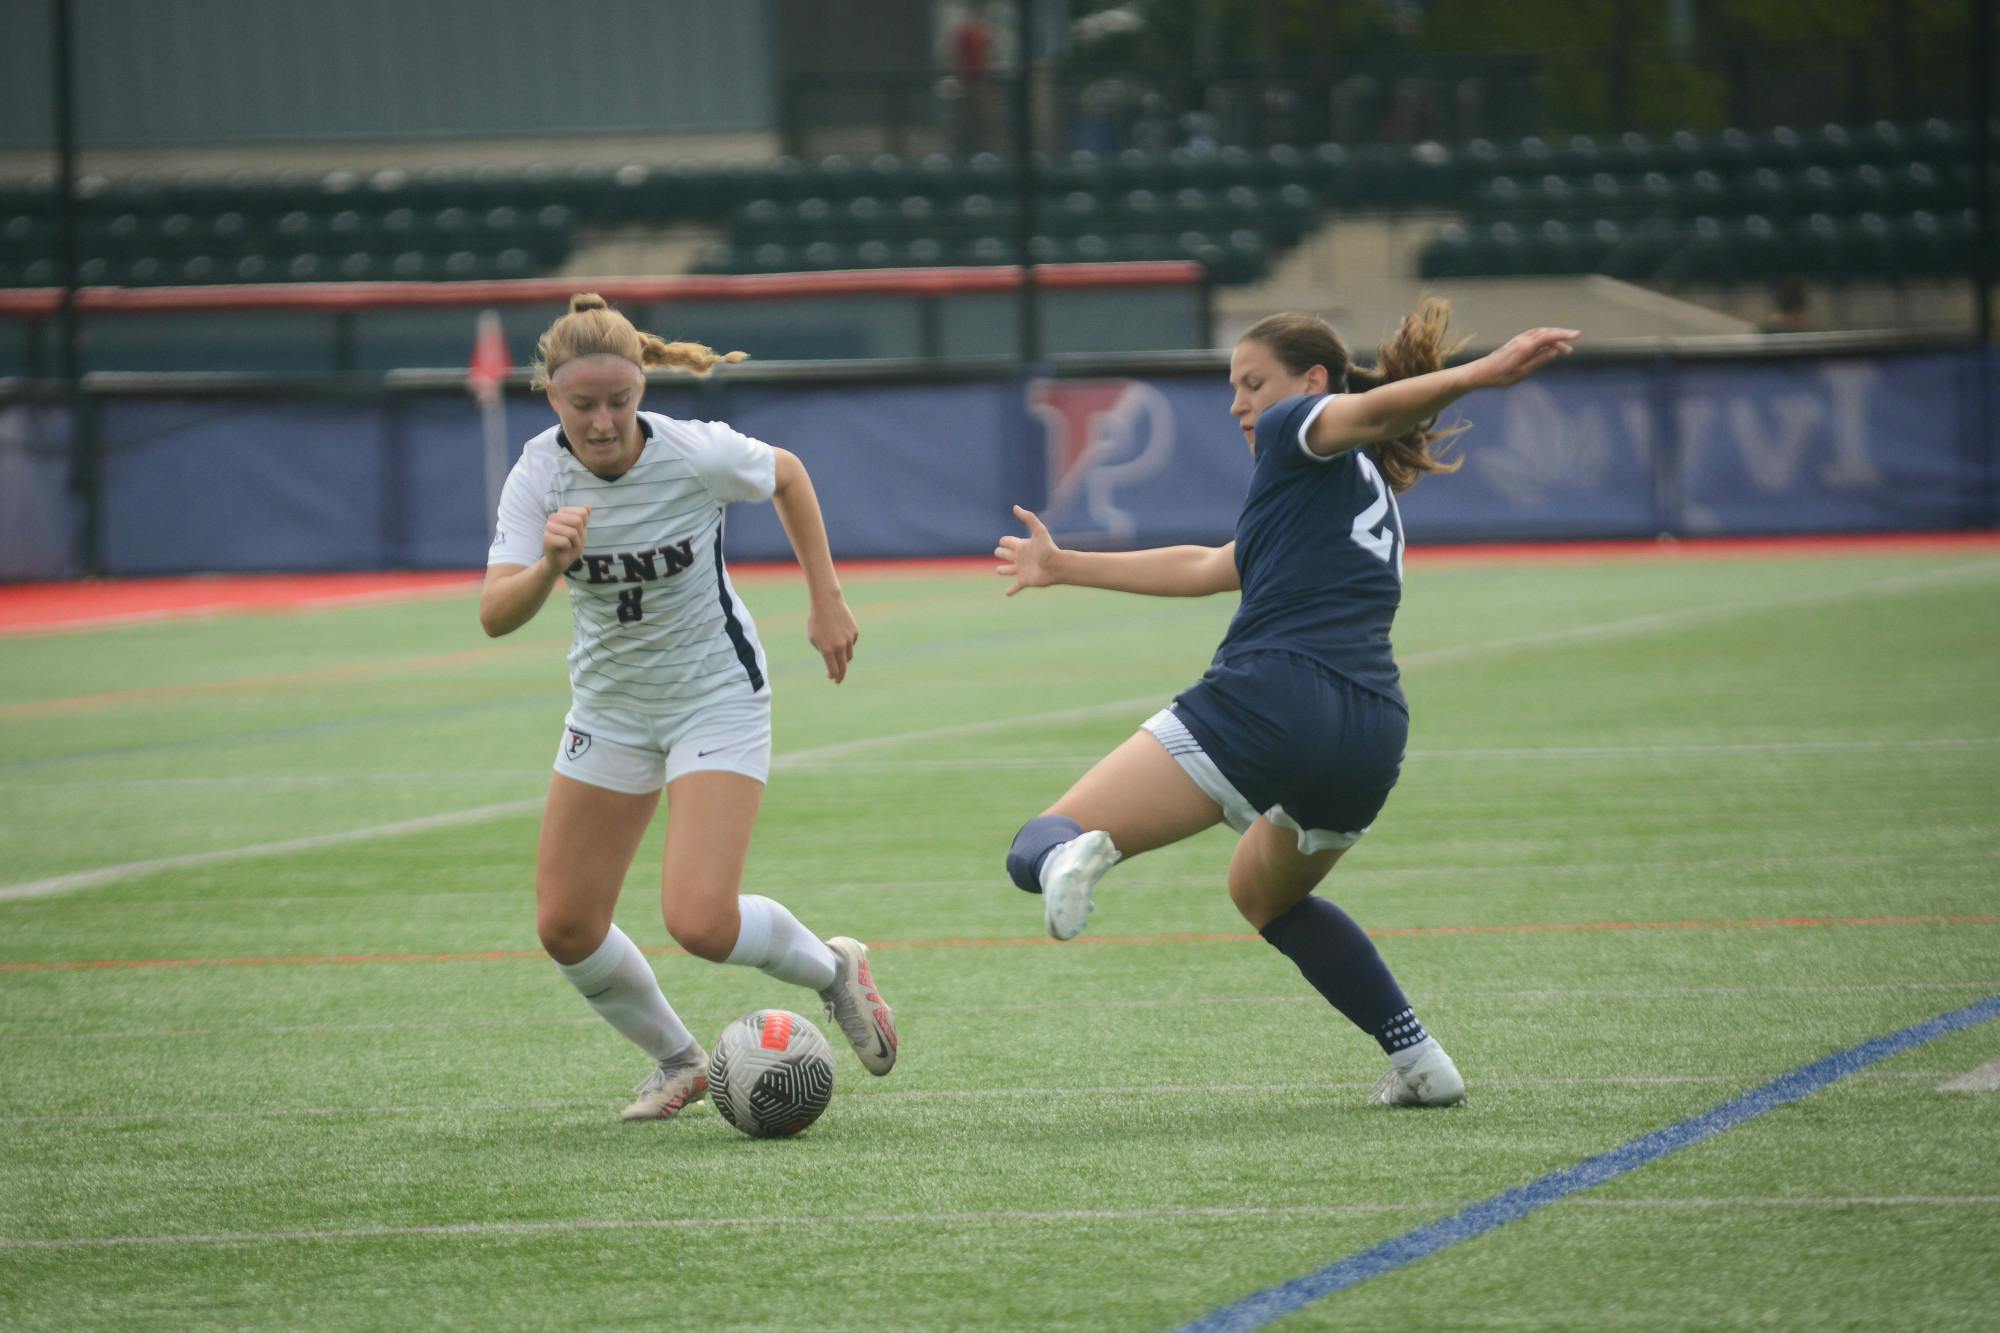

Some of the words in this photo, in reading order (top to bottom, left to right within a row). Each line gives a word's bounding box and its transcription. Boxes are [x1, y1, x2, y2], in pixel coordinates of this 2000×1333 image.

[1350, 452, 1405, 583] 2
[616, 586, 643, 624] 8
[569, 734, 584, 753] P
